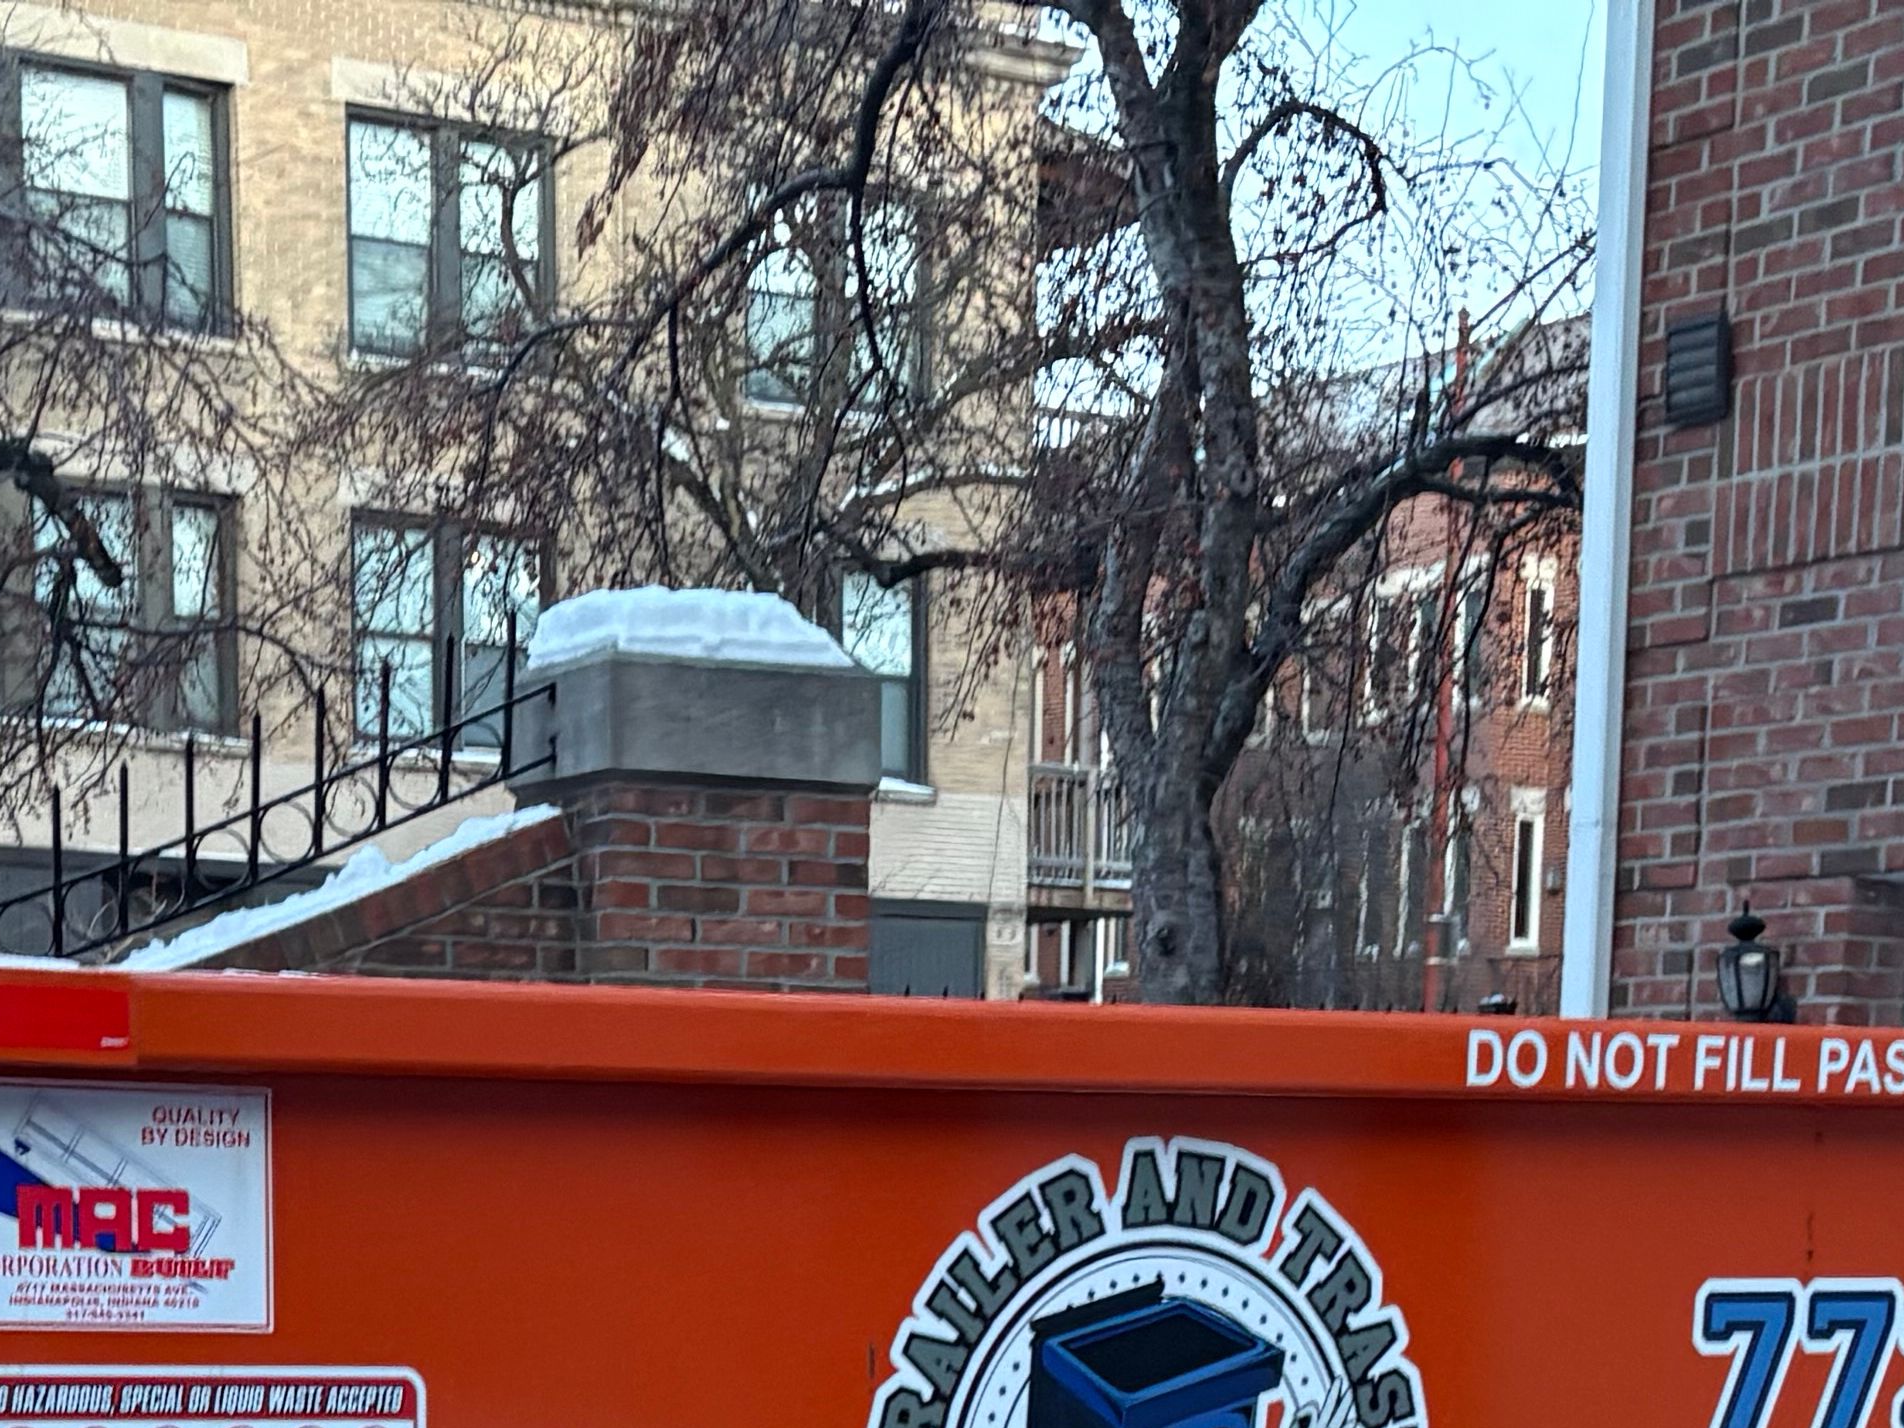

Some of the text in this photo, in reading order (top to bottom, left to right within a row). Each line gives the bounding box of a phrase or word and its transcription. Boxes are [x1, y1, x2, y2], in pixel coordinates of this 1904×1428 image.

[1465, 1029, 1549, 1089] DO
[1565, 1031, 1679, 1091] NOT
[1695, 1034, 1800, 1093] FILL
[141, 1128, 250, 1148] BY DESIGN
[152, 1106, 240, 1126] QUALITY
[16, 1184, 189, 1253] MAC
[1121, 1150, 1276, 1247] AND
[11, 1384, 115, 1416] HAZARDOUS,
[119, 1384, 184, 1414] SPECIAL
[188, 1385, 211, 1414] OR
[213, 1385, 265, 1415] LIQUID
[268, 1385, 322, 1414] WASTE
[325, 1385, 404, 1414] ACCEPTED
